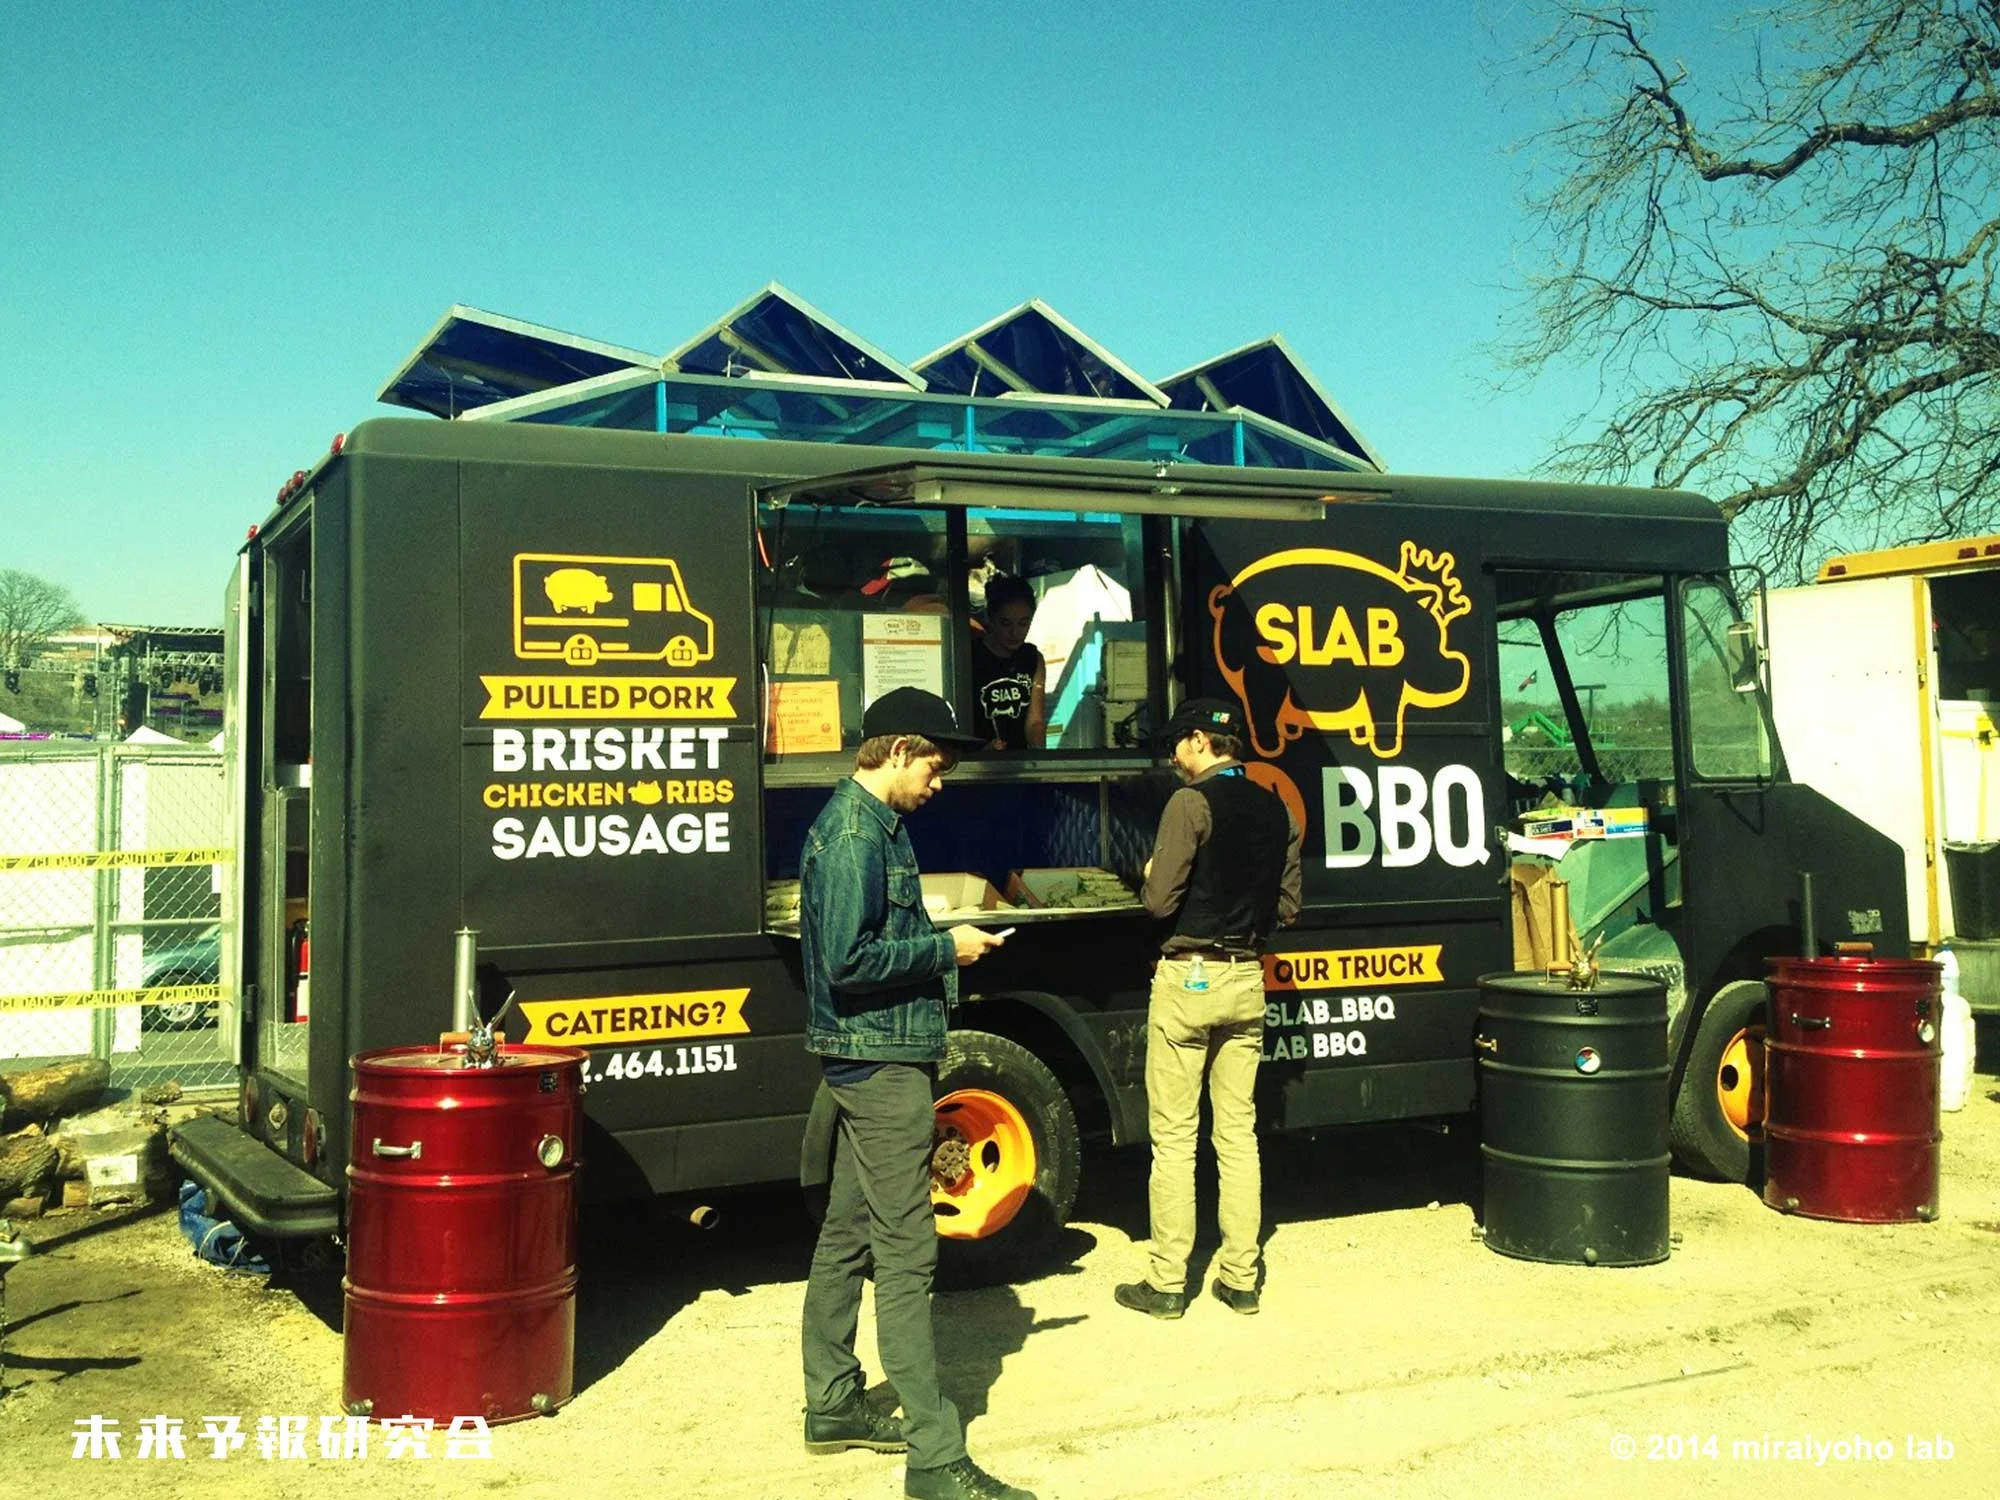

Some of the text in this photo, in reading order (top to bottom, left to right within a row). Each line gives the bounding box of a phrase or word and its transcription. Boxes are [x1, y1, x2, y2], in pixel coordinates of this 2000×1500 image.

[1255, 603, 1404, 666] SLAB
[503, 685, 714, 709] PULLED PORK
[991, 687, 1021, 702] SLAB
[492, 727, 729, 772] BRISKET
[482, 780, 734, 808] CHICKEN RIBS
[1322, 764, 1490, 868] BBQ
[492, 812, 731, 860] SAUSAGE
[1273, 953, 1424, 984] OUR TRUCK
[546, 1001, 726, 1037] CATERING?
[1265, 995, 1396, 1027] SLAB_BBQ
[1312, 1030, 1367, 1059] BBQ
